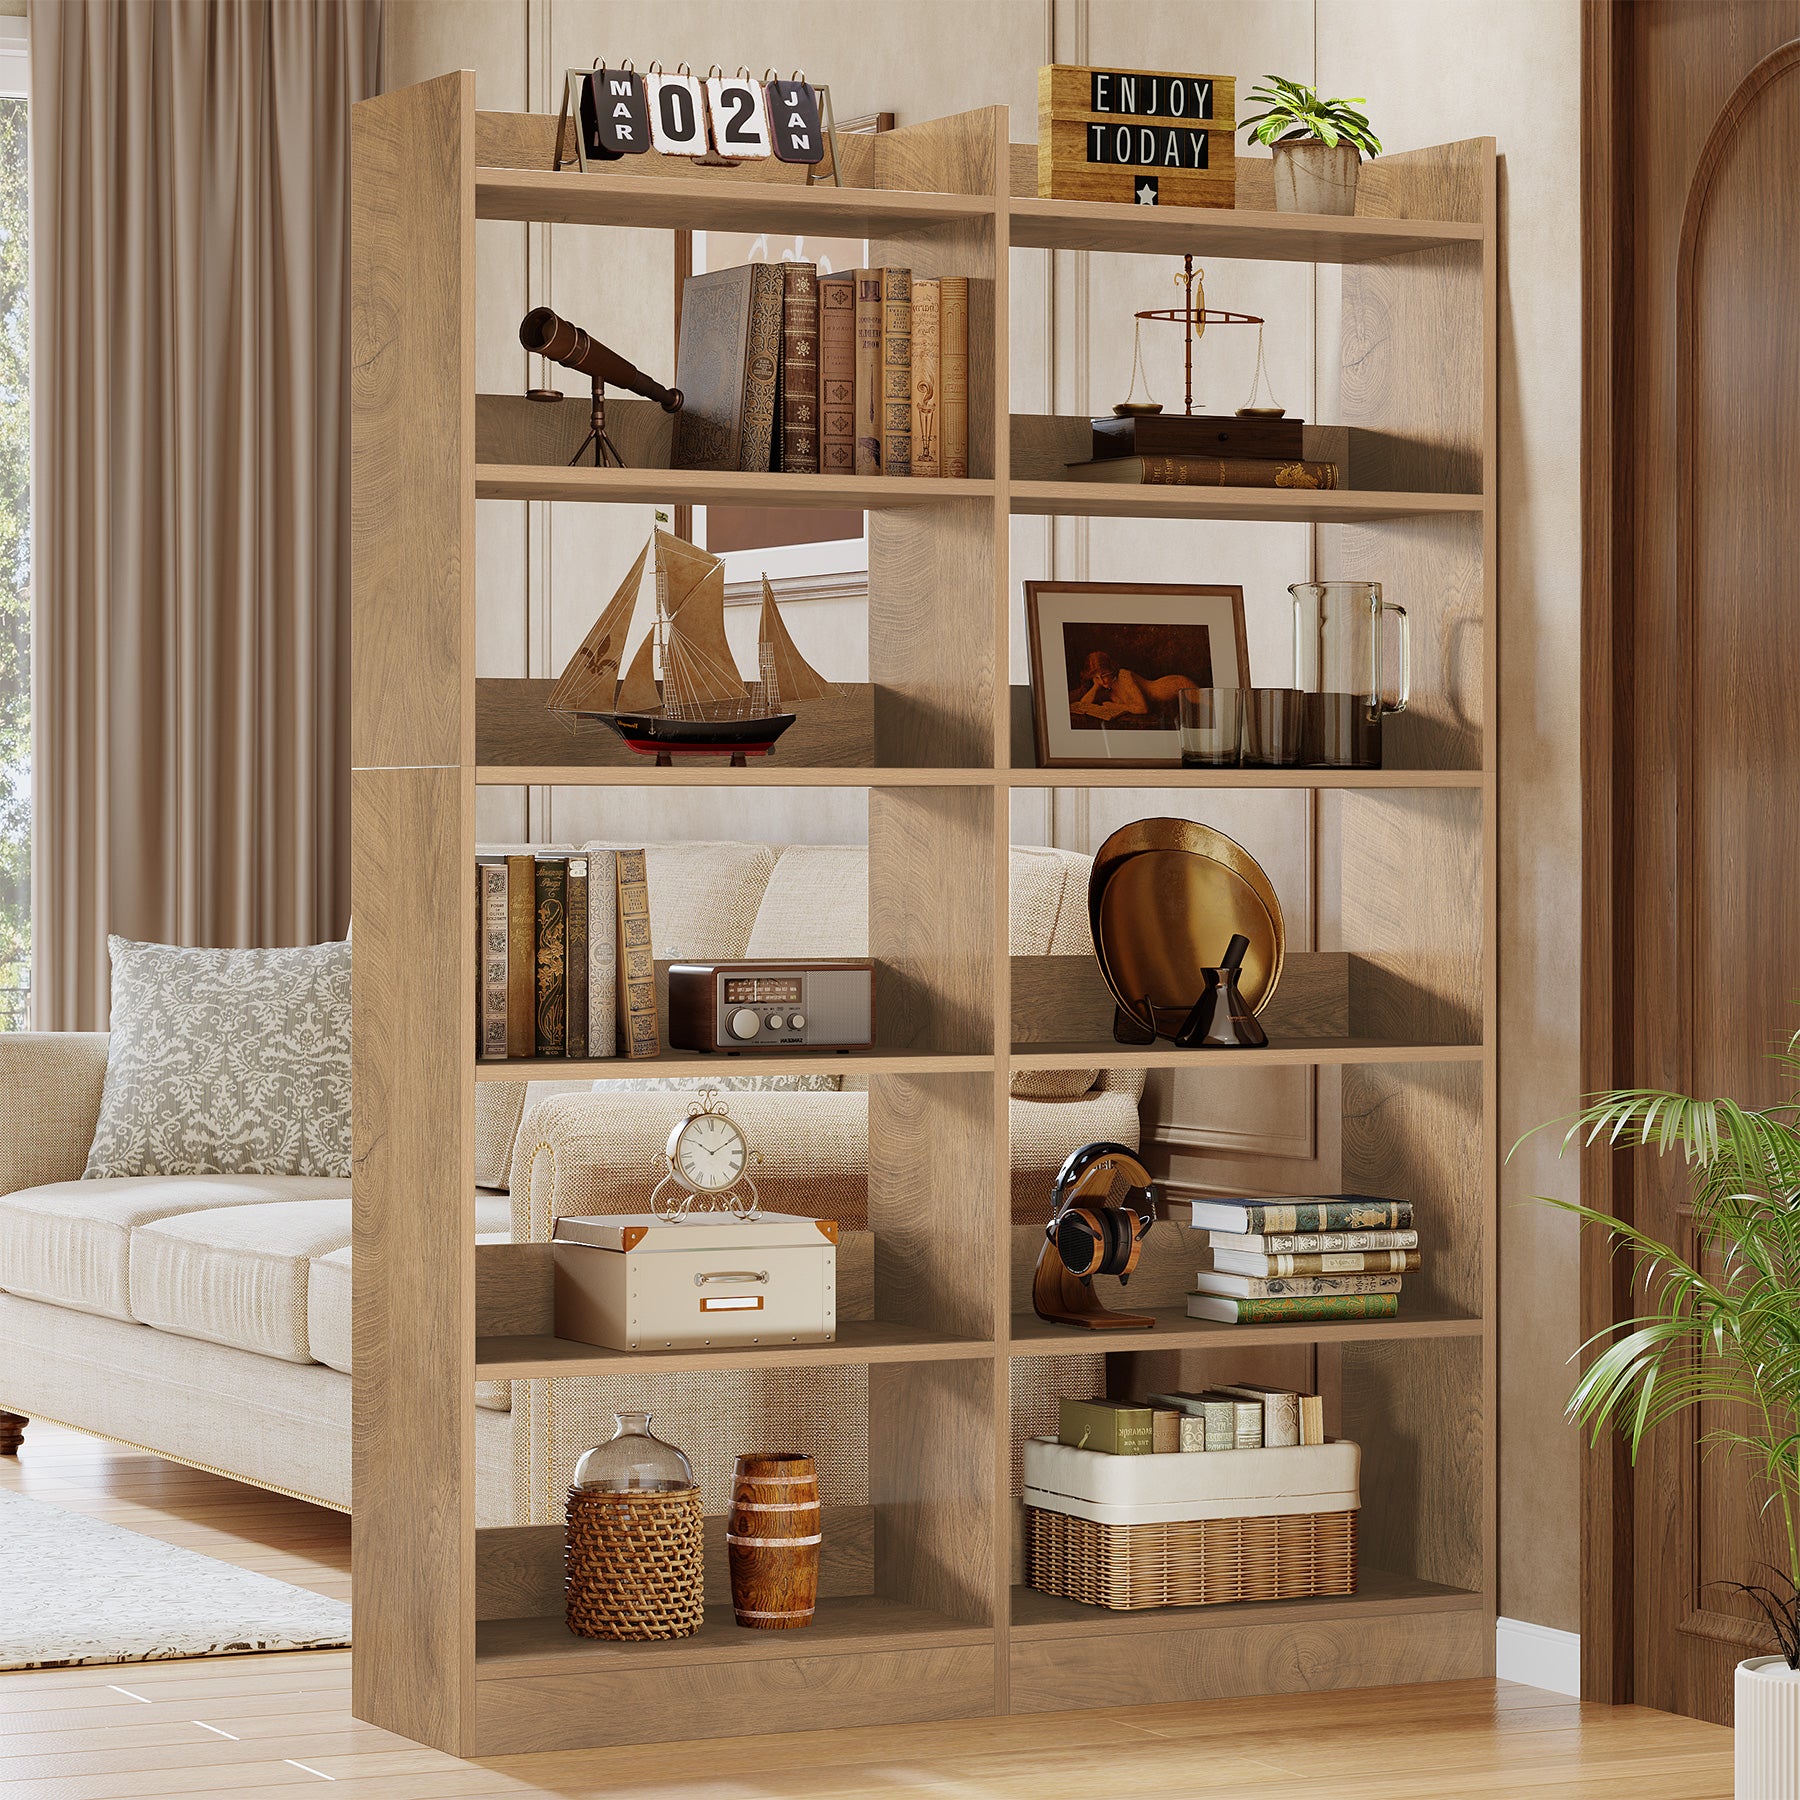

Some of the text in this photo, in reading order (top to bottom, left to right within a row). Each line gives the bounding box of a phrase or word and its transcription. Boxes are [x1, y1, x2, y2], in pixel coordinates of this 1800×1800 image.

[610, 80, 634, 141] MAR
[783, 91, 811, 150] JAN
[1097, 75, 1209, 119] ENJOY
[1092, 125, 1205, 168] TODAY
